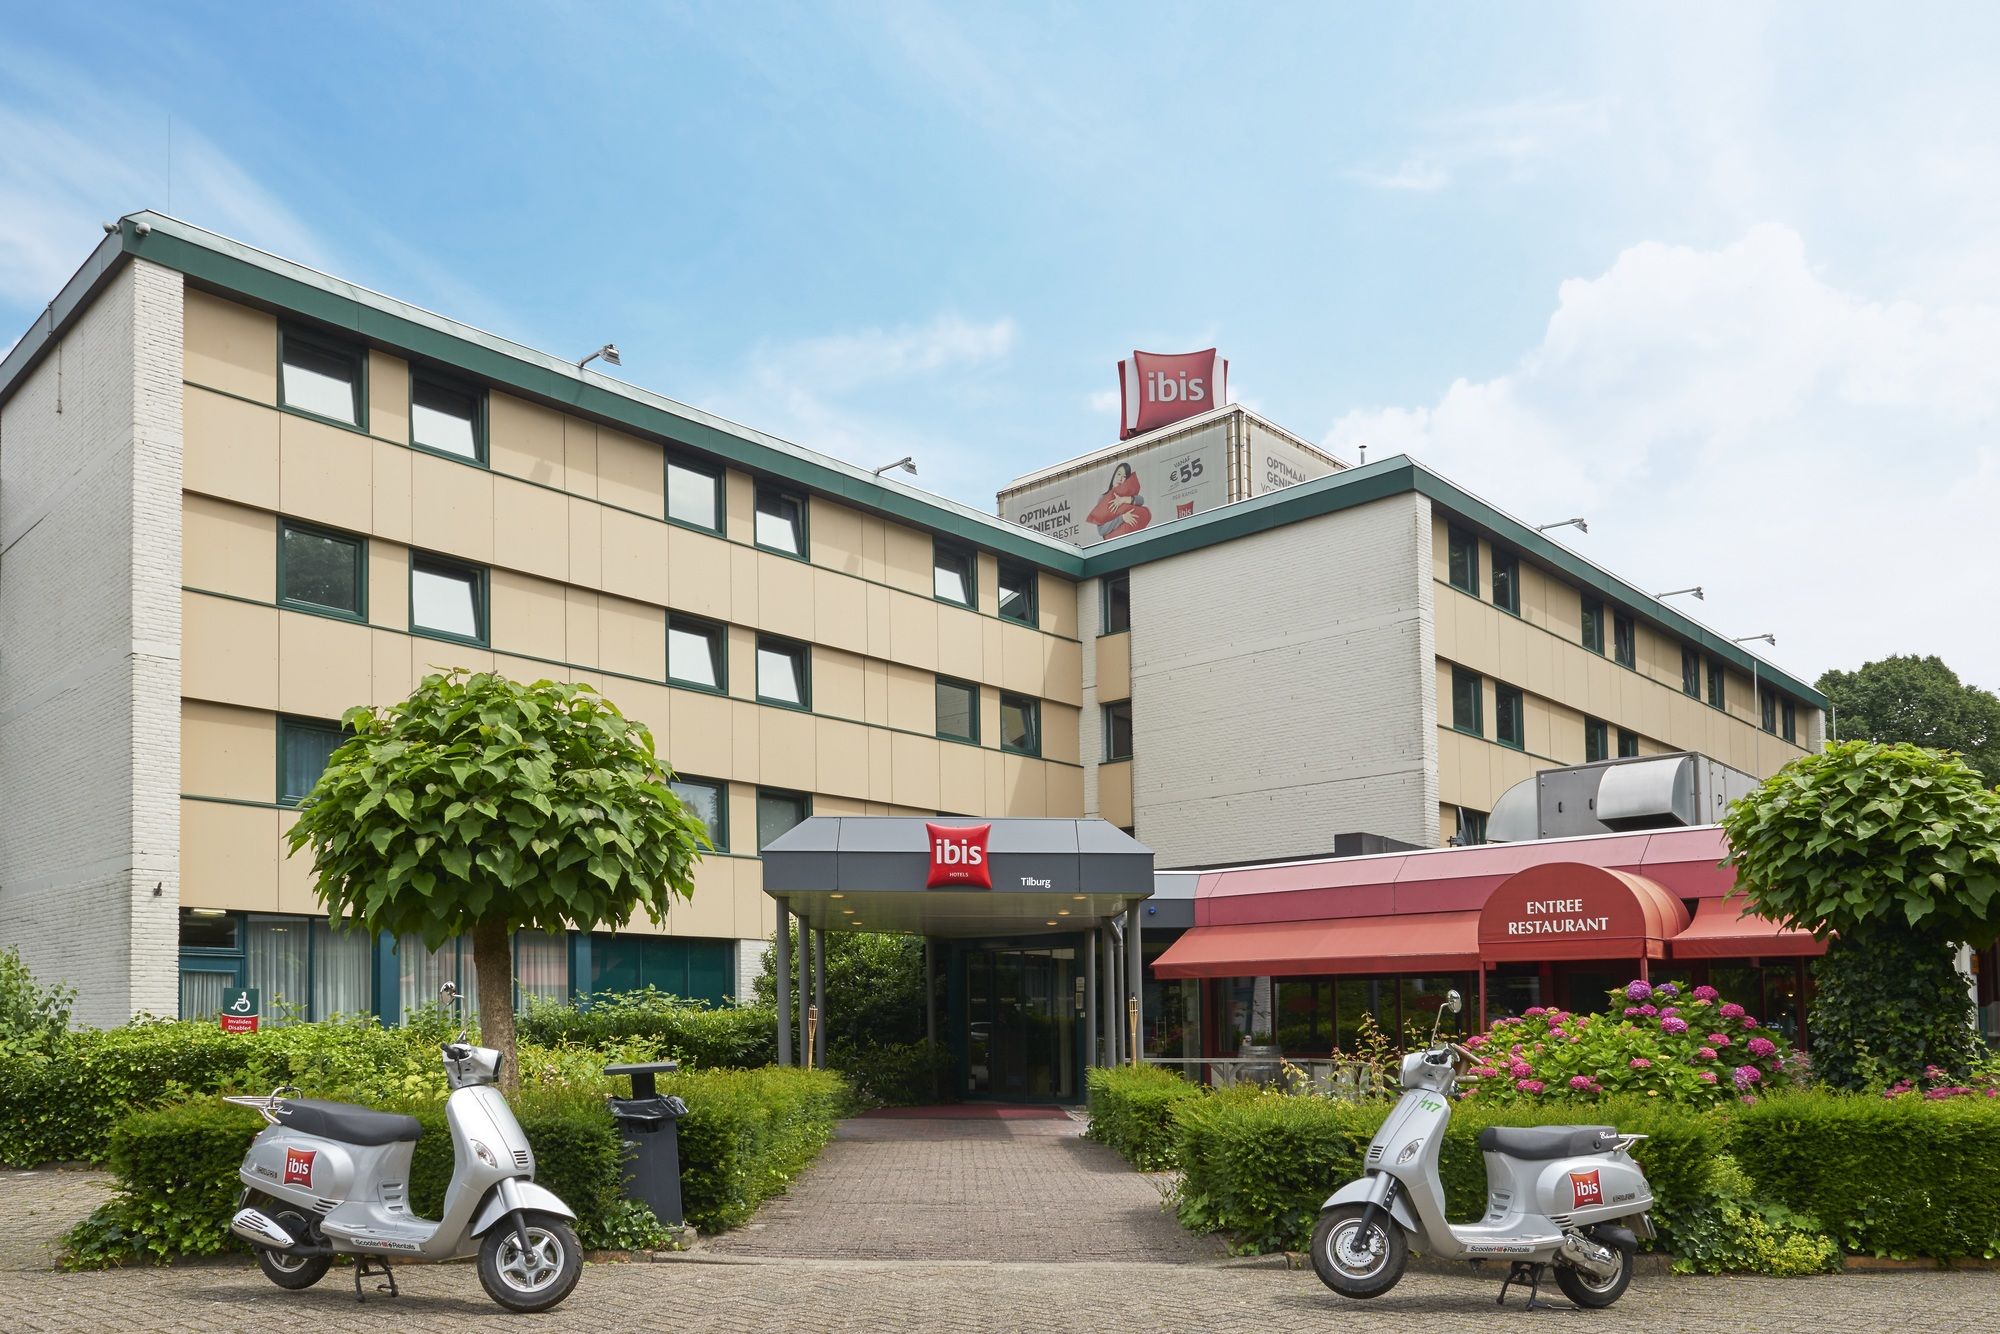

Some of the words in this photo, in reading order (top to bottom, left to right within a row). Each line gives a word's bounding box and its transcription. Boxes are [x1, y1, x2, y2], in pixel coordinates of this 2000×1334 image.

[1148, 371, 1204, 402] ibis
[1174, 456, 1190, 468] VANAF
[1267, 471, 1295, 488] GENI
[1020, 500, 1071, 524] OPTIMAAL
[1028, 513, 1071, 532] NIETEN
[1052, 525, 1079, 539] BESTE
[936, 839, 982, 865] ibis
[1020, 877, 1051, 889] Tilburg
[1526, 899, 1583, 914] ENTREE
[1508, 917, 1609, 935] RESTAURANT
[1421, 1100, 1442, 1112] 117
[288, 1158, 309, 1175] ibis
[1576, 1180, 1599, 1197] ibis
